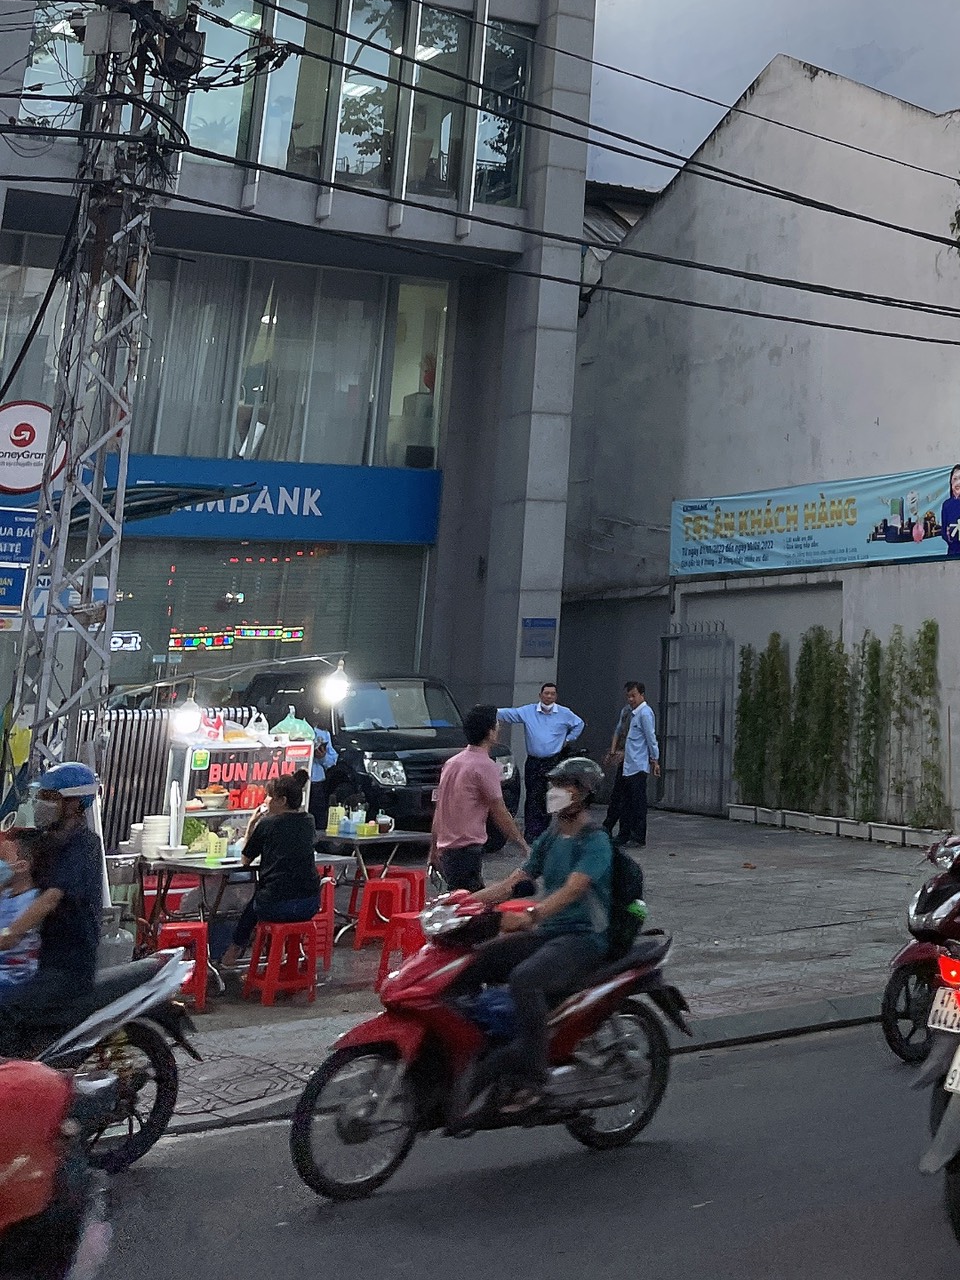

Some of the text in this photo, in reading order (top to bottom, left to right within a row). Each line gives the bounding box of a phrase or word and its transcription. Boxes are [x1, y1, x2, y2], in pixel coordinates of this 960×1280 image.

[0, 450, 46, 462] oneyGra
[738, 499, 798, 537] KHÁCH
[804, 493, 857, 531] HÀNG
[0, 526, 14, 537] UA
[209, 754, 248, 783] BÚN
